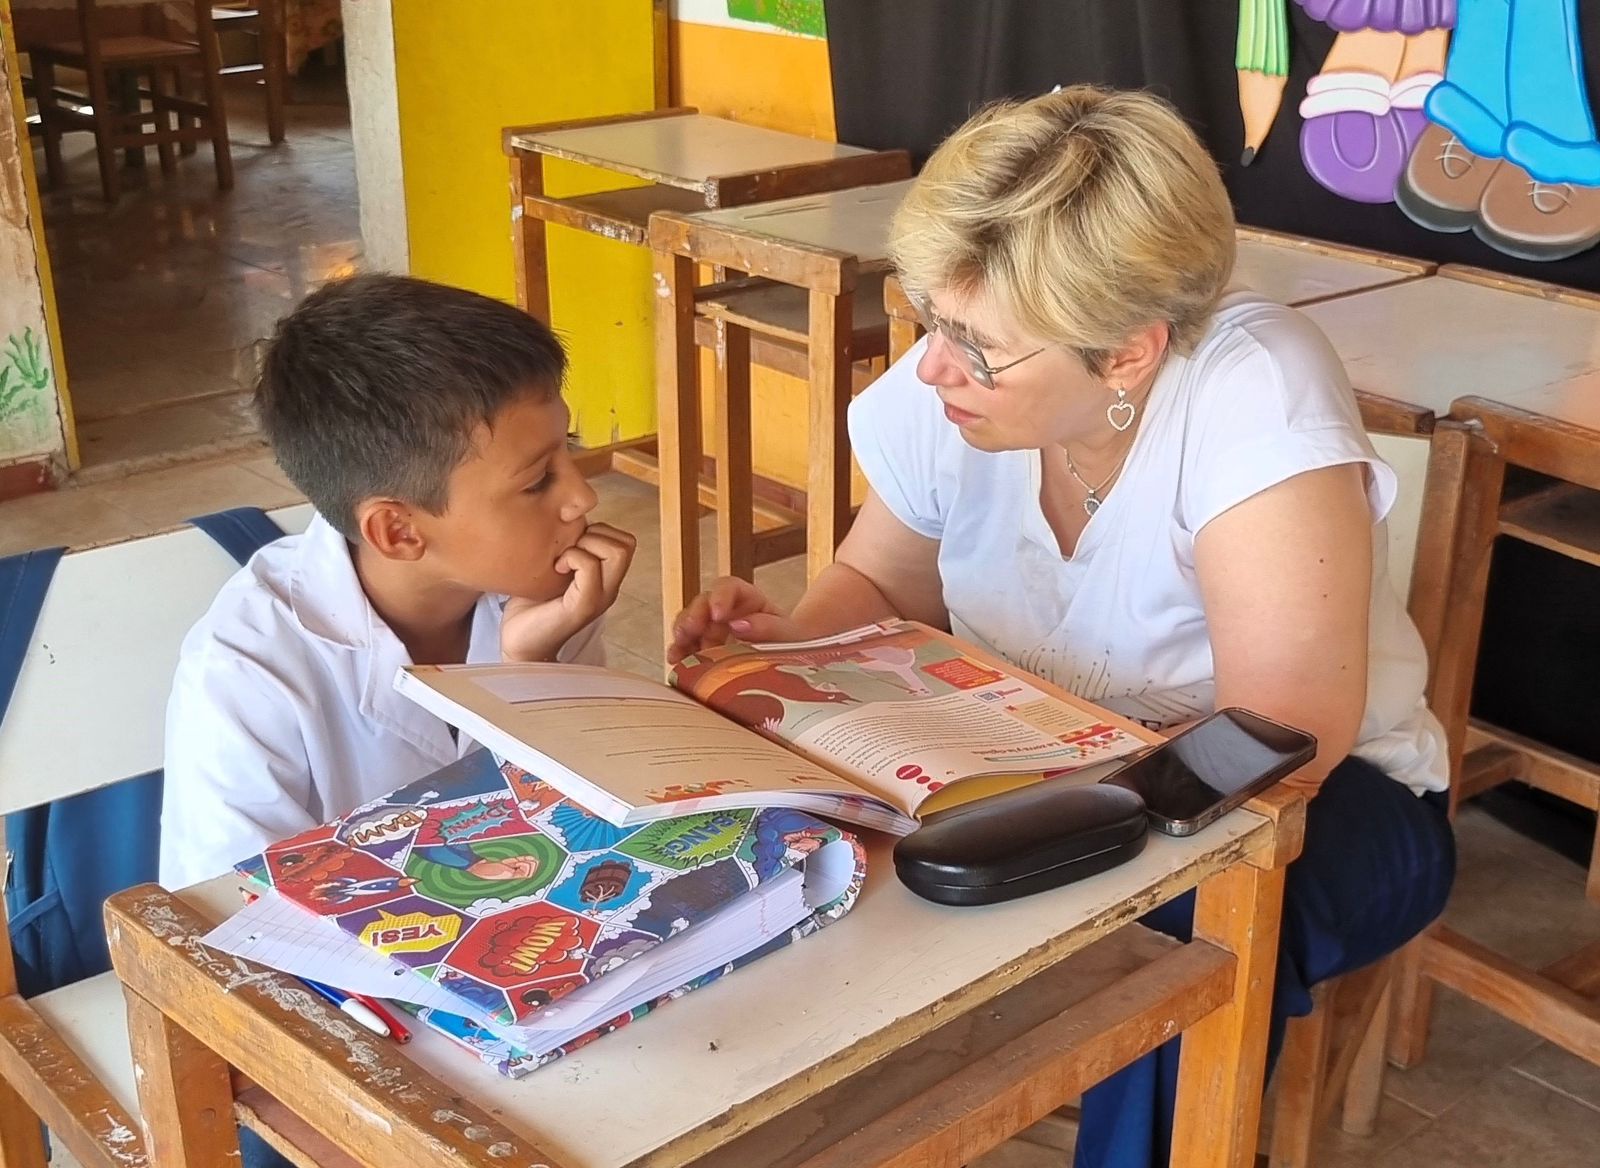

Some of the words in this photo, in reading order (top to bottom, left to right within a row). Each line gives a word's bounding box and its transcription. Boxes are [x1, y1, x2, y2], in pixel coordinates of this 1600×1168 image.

[347, 809, 422, 848] BAM!
[663, 816, 736, 857] BANG!
[372, 923, 443, 947] YES!
[502, 921, 567, 973] WOW!
